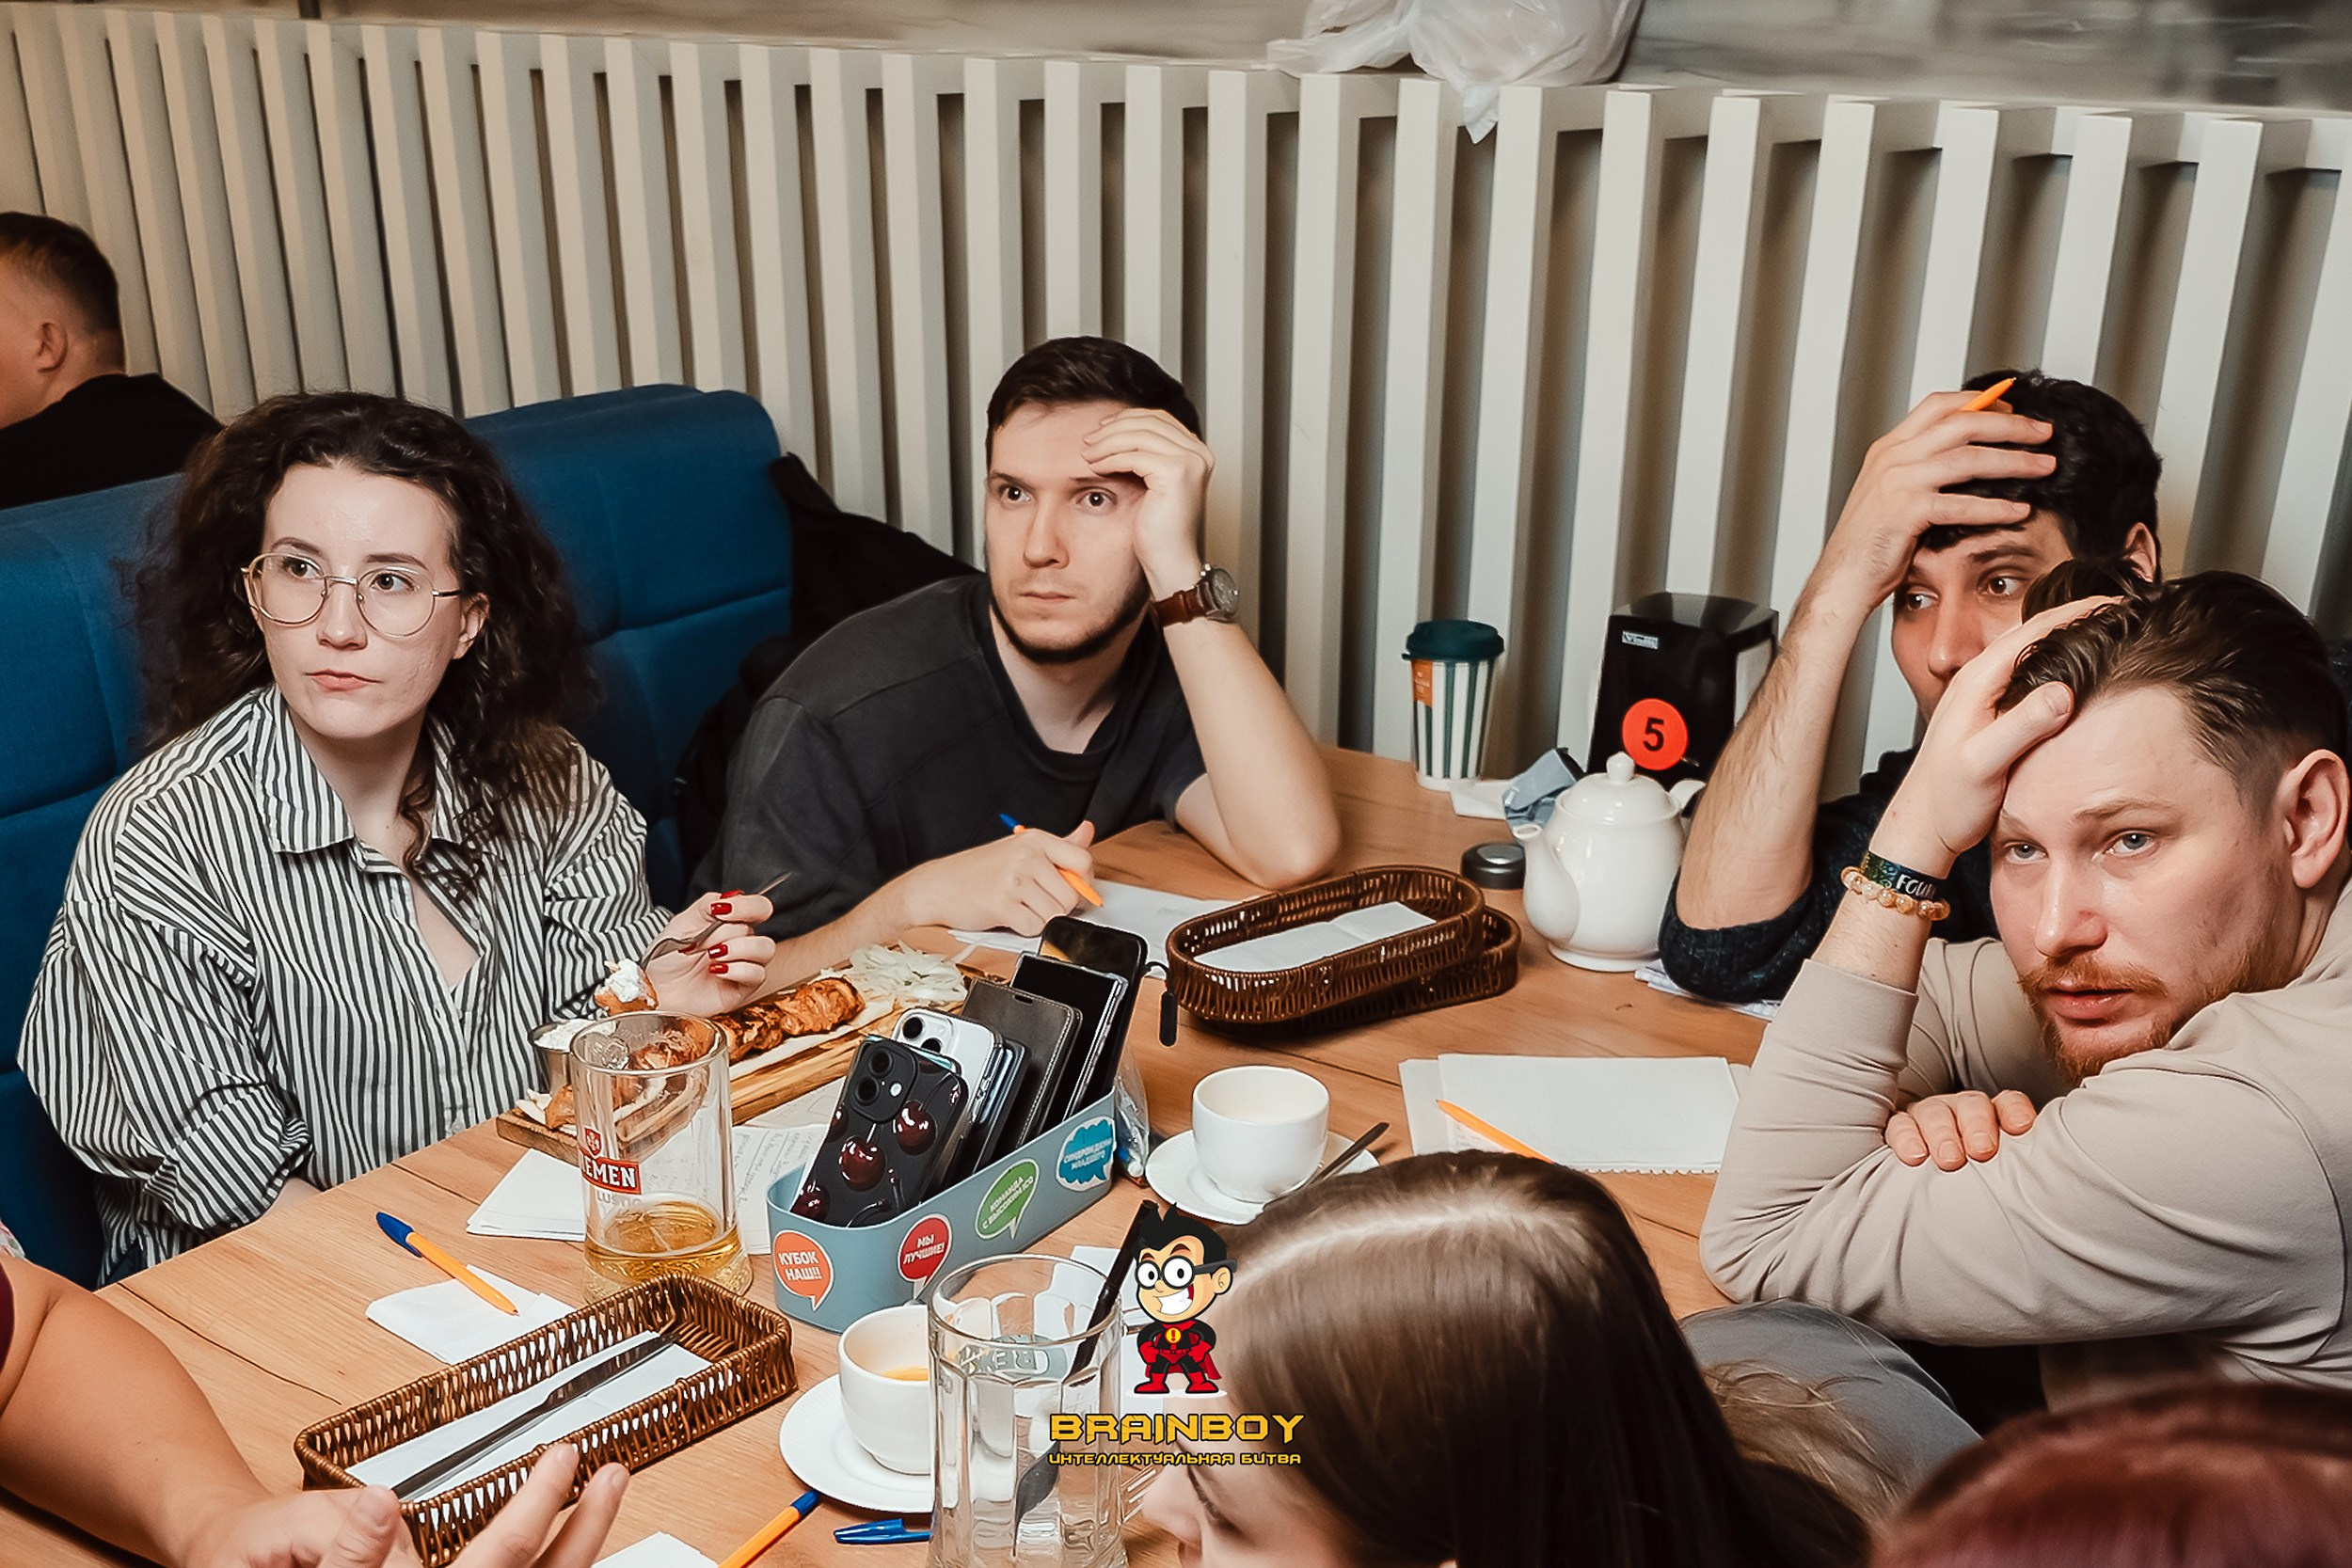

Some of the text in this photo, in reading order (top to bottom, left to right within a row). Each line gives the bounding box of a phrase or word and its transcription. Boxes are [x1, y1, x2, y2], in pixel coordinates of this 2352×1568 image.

[1643, 717, 1664, 752] 5
[990, 1176, 1024, 1212] КОМАНДА
[917, 1234, 934, 1248] МЫ
[778, 1251, 818, 1265] КУБОК
[903, 1242, 945, 1264] ЛУЧШИЕ!
[785, 1267, 822, 1280] НАШ!!
